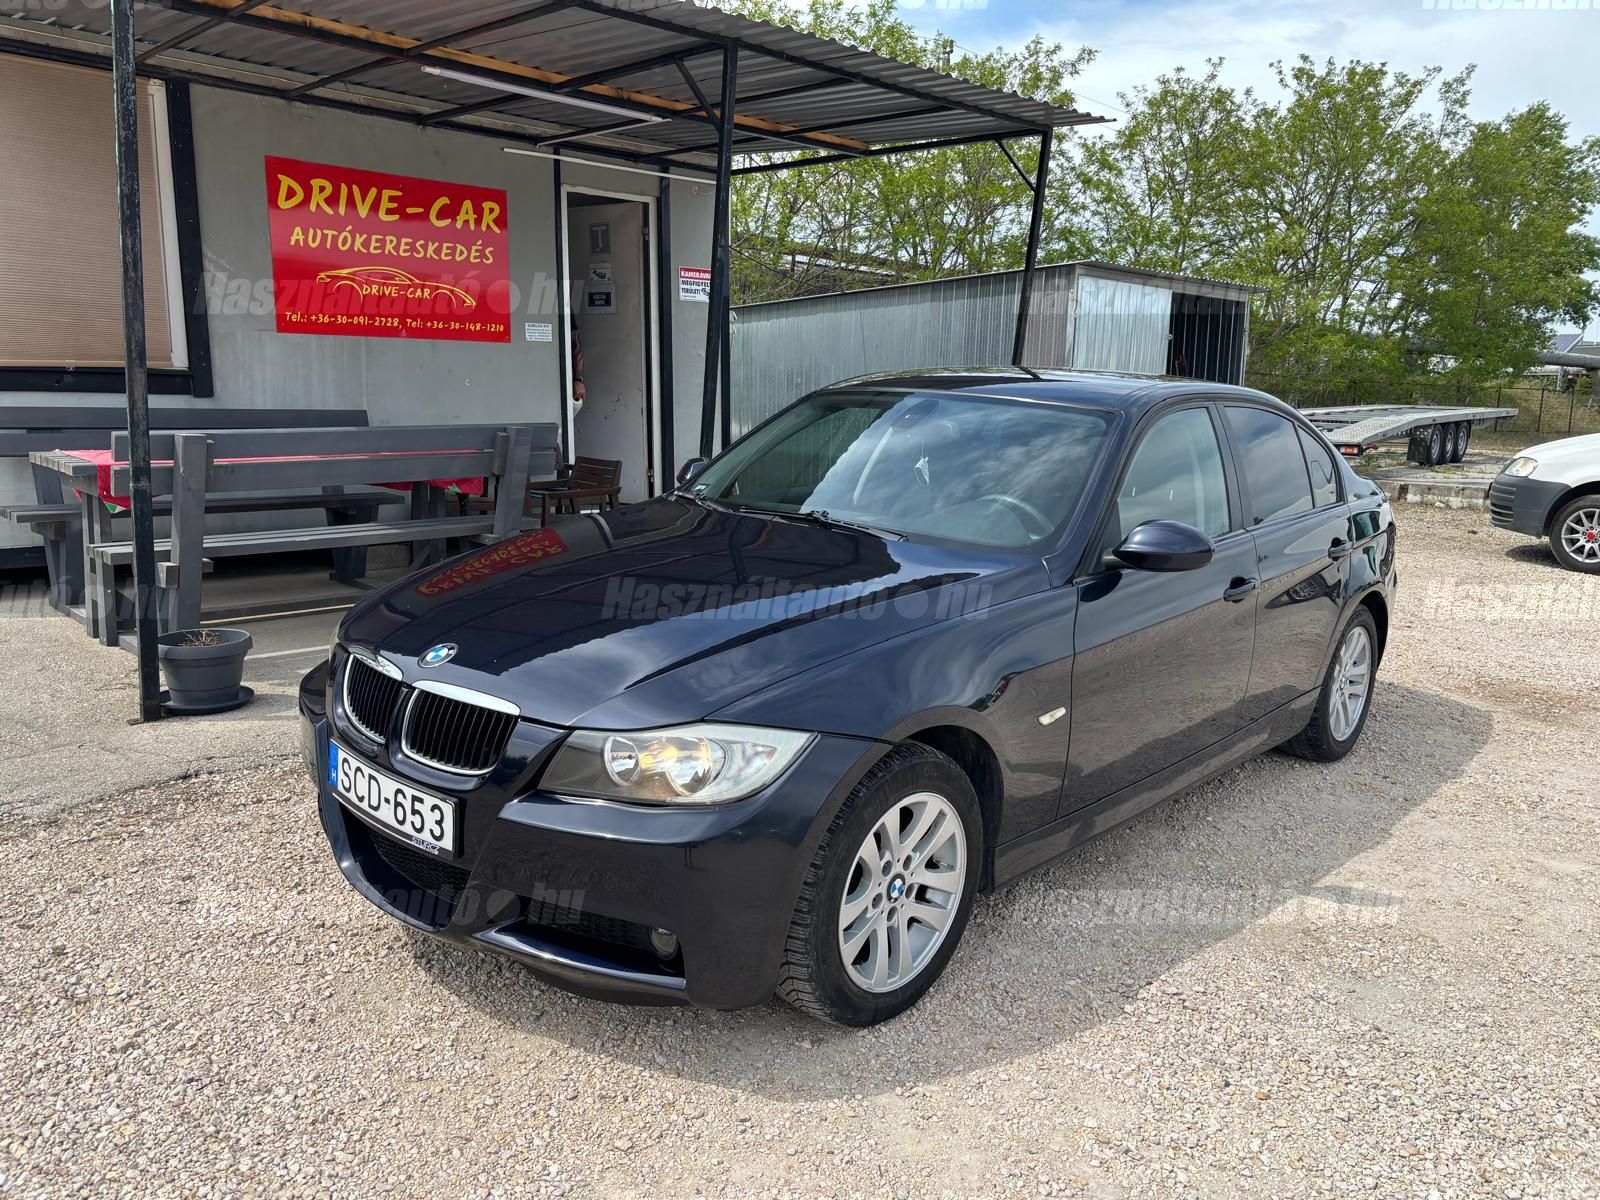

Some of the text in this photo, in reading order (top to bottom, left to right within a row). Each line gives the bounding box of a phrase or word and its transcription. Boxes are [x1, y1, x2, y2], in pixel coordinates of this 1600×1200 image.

[277, 174, 501, 234] DRIVE-CAR
[289, 225, 495, 265] AUTÓKERESKEDÉS
[362, 284, 431, 299] DRIVE-CAR
[681, 279, 710, 288] MEGFIGYEL
[285, 312, 308, 323] Tel.:
[406, 318, 424, 329] Tel:
[341, 757, 445, 842] SCD-653
